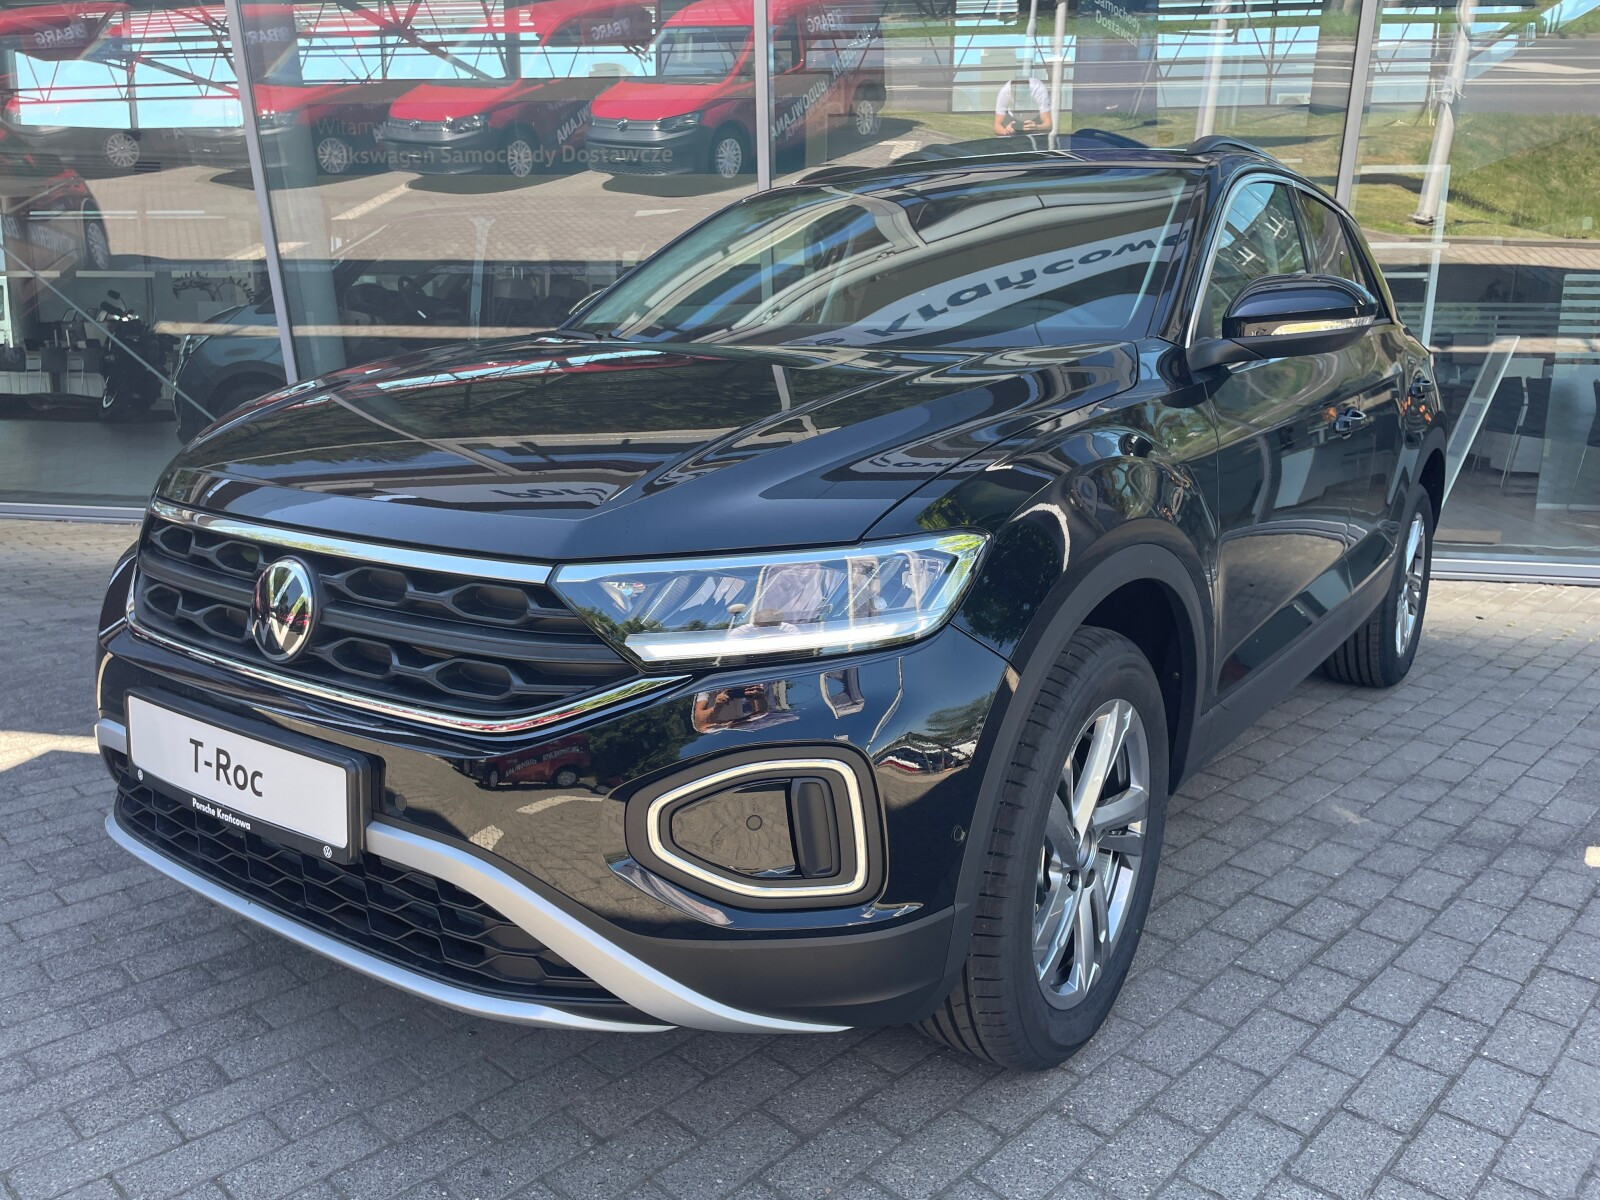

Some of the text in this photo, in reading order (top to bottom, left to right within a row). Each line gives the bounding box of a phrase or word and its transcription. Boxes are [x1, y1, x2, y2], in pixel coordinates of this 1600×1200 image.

[1095, 9, 1138, 48] Dostawcze
[562, 145, 673, 164] Dostawcze
[190, 738, 263, 797] T-Roc
[192, 797, 251, 830] Porsche Krańcowa
